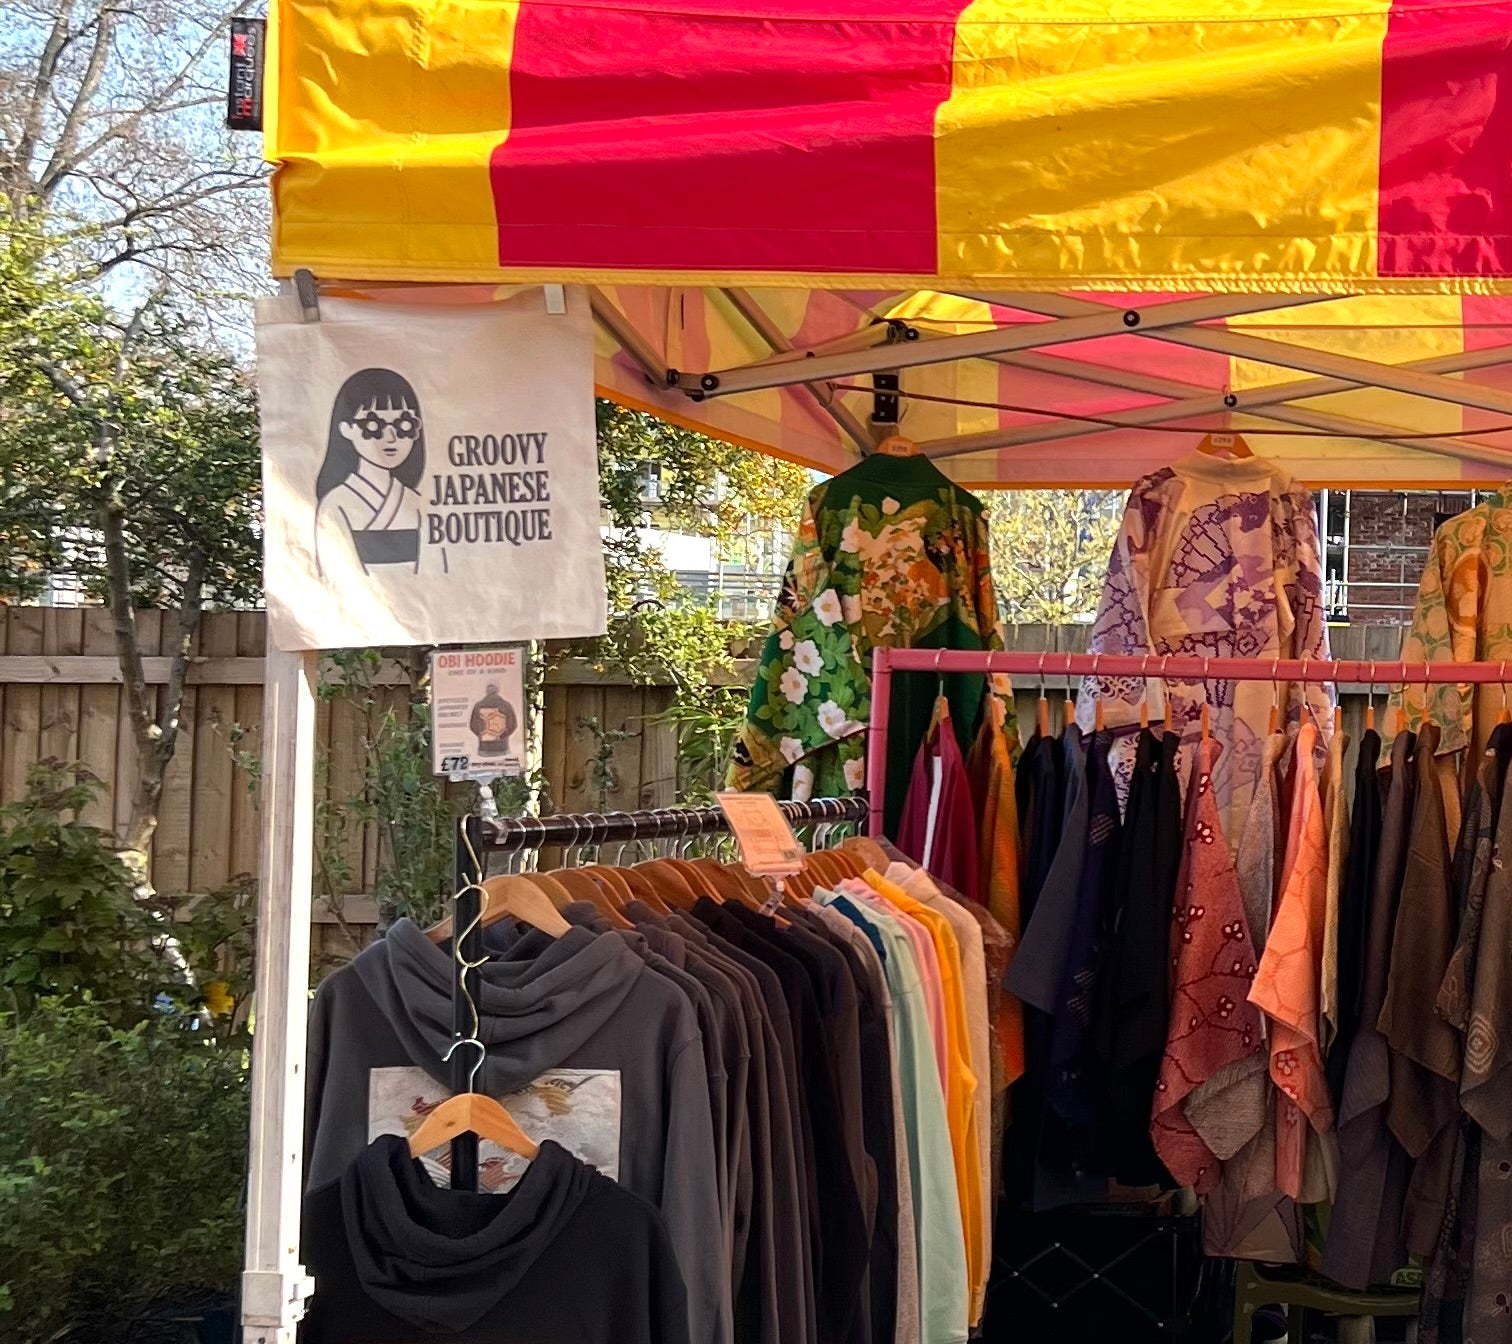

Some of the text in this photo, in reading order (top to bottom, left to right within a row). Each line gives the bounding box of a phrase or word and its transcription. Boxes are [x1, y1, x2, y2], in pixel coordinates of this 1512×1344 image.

[448, 432, 548, 467] GROOVY
[430, 470, 550, 506] JAPANESE
[427, 509, 552, 546] BOUTIQUE
[437, 652, 515, 668] OBI HOODIE
[441, 756, 469, 771] £72
